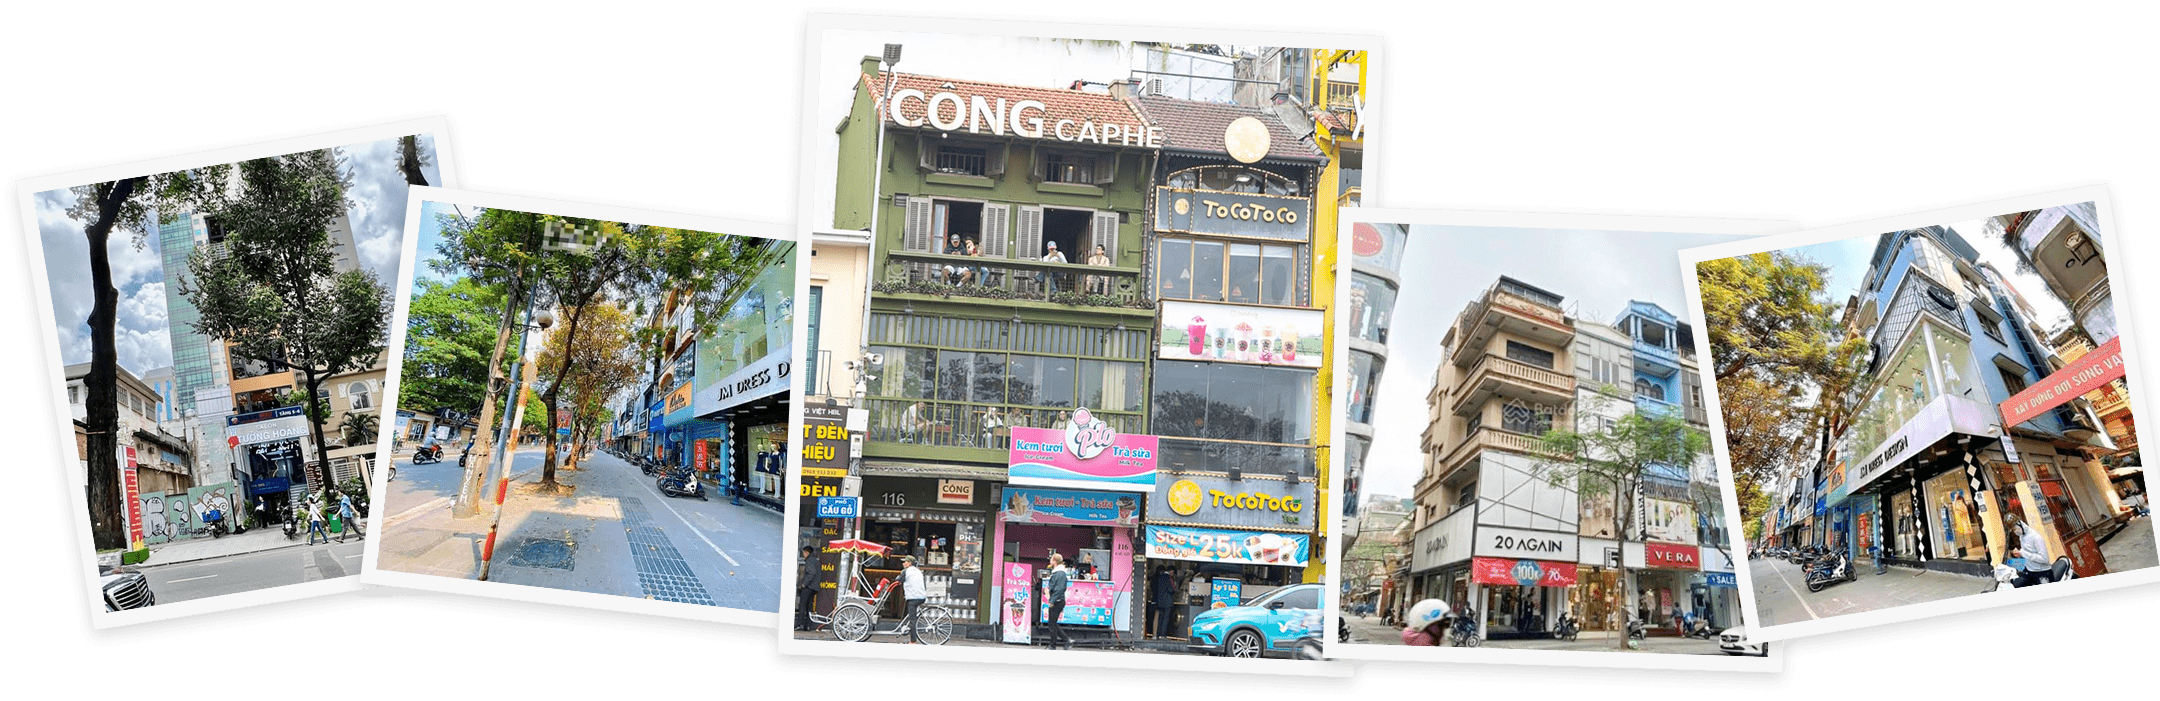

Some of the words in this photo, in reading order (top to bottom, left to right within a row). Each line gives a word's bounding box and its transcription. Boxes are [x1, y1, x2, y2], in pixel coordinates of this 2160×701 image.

[736, 368, 772, 395] DRESS
[777, 361, 791, 379] D
[1016, 439, 1039, 451] Kem
[1112, 445, 1130, 457] Trà
[882, 492, 906, 506] 116
[1156, 530, 1187, 546] Size
[1190, 533, 1200, 546] L
[1494, 535, 1514, 549] 20
[1516, 538, 1562, 553] AGAIN
[1653, 550, 1694, 564] VERA
